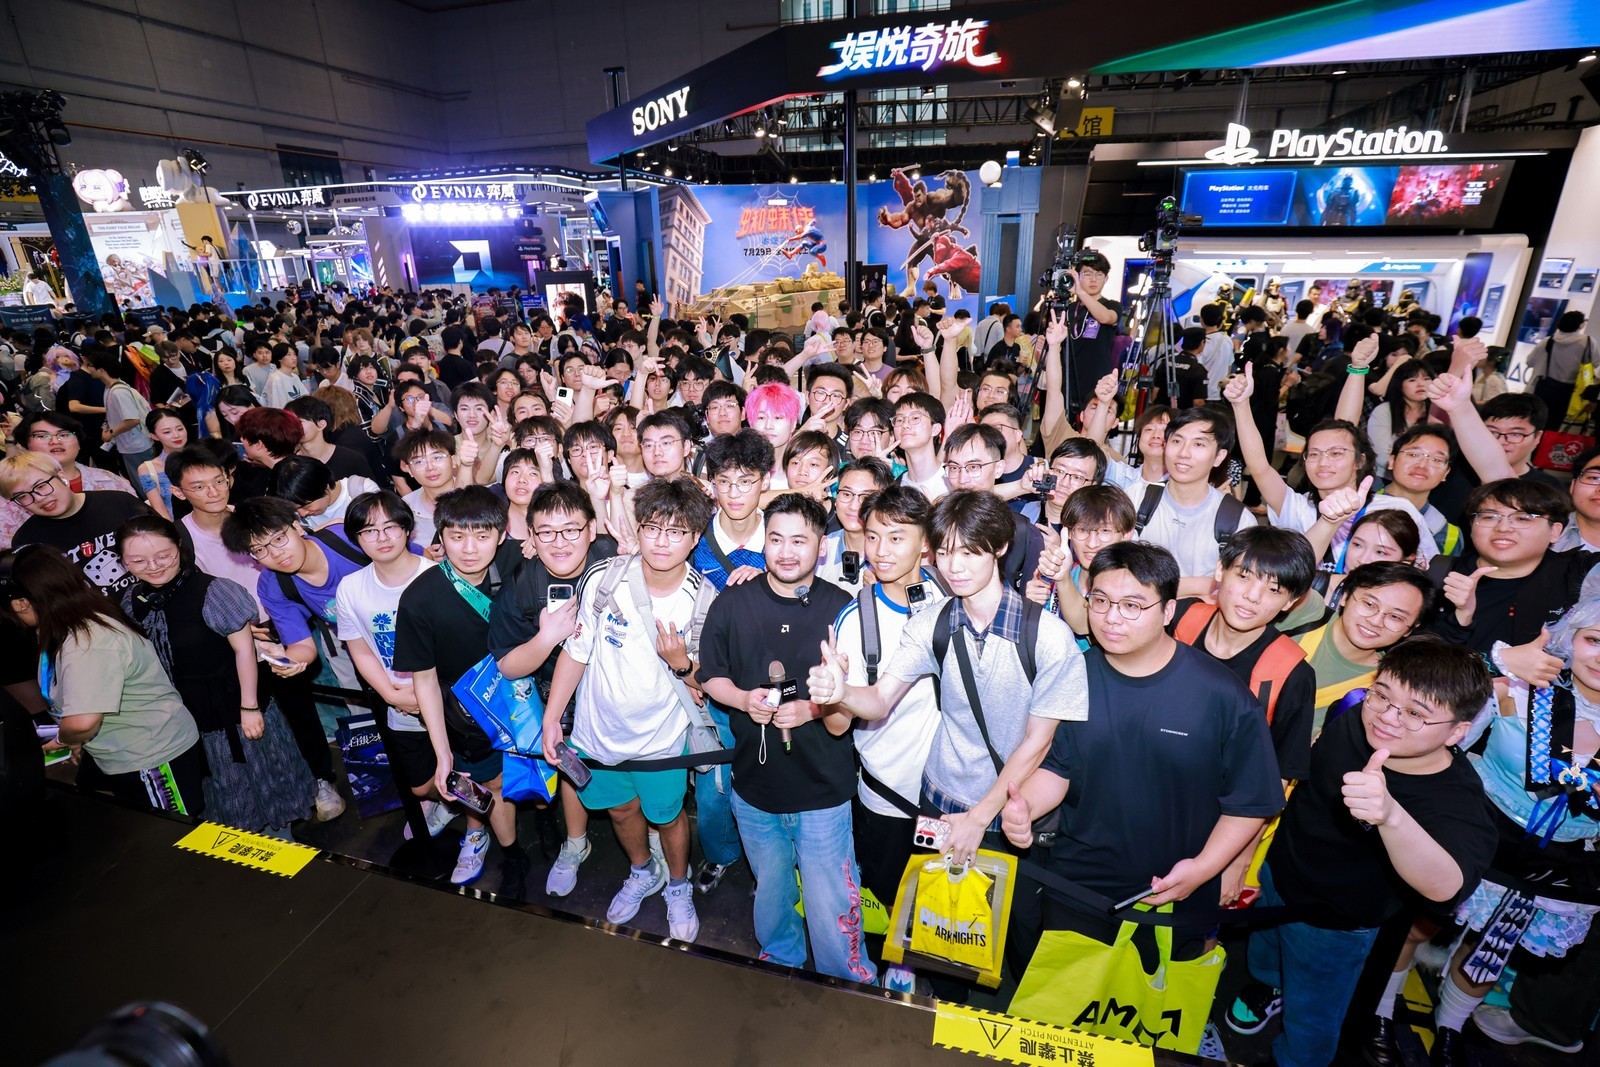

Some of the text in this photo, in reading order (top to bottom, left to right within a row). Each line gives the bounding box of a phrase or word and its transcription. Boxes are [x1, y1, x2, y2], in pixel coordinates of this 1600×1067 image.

[816, 18, 1001, 77] 娱悦奇旅
[632, 86, 691, 136] SONY
[260, 190, 301, 207] EVNIA
[431, 185, 485, 200] EVNIA
[736, 206, 817, 239] 蜘蛛侠
[228, 843, 276, 862] 禁止攀爬
[935, 925, 987, 947] ARKNIGHTS
[1020, 1027, 1095, 1049] ATTENTION PITCH
[1019, 1037, 1095, 1067] 禁止攀爬
